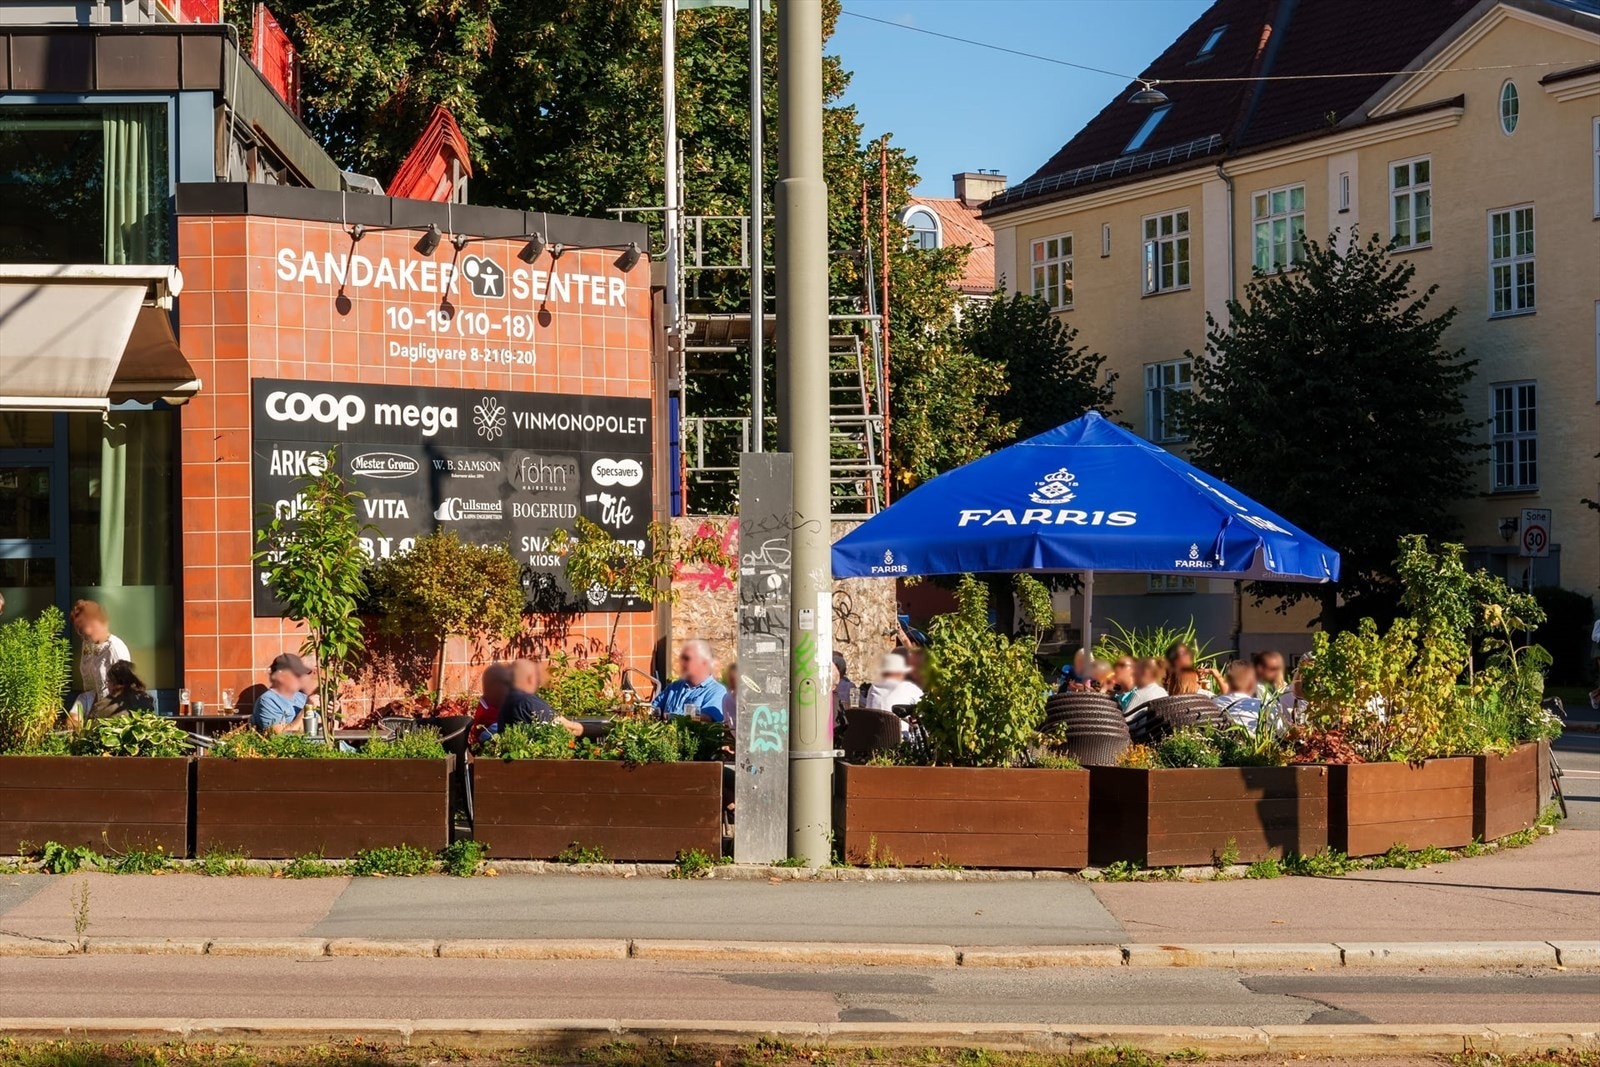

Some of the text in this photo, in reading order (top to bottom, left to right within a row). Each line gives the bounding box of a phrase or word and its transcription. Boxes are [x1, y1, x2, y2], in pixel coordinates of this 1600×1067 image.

[277, 247, 626, 307] SANDAKER SENTER
[386, 306, 535, 342] 10-19 (10-18)
[389, 341, 467, 363] Dagligvare
[265, 391, 458, 436] coop mega
[512, 411, 647, 435] VINMONOPOLET
[355, 456, 415, 470] Mester Grønn
[432, 459, 501, 472] W. B. SAMSON
[521, 456, 566, 484] föhn
[596, 465, 638, 478] Specsavers
[362, 499, 410, 519] VITA
[449, 497, 503, 521] Gullsmed
[512, 502, 577, 519] BOGERUD
[957, 508, 1138, 527] FARRIS
[1526, 511, 1546, 521] Sone
[1528, 532, 1542, 547] 30
[529, 554, 561, 567] KIOSK
[871, 564, 908, 574] FARRIS
[1174, 559, 1213, 568] FARRIS
